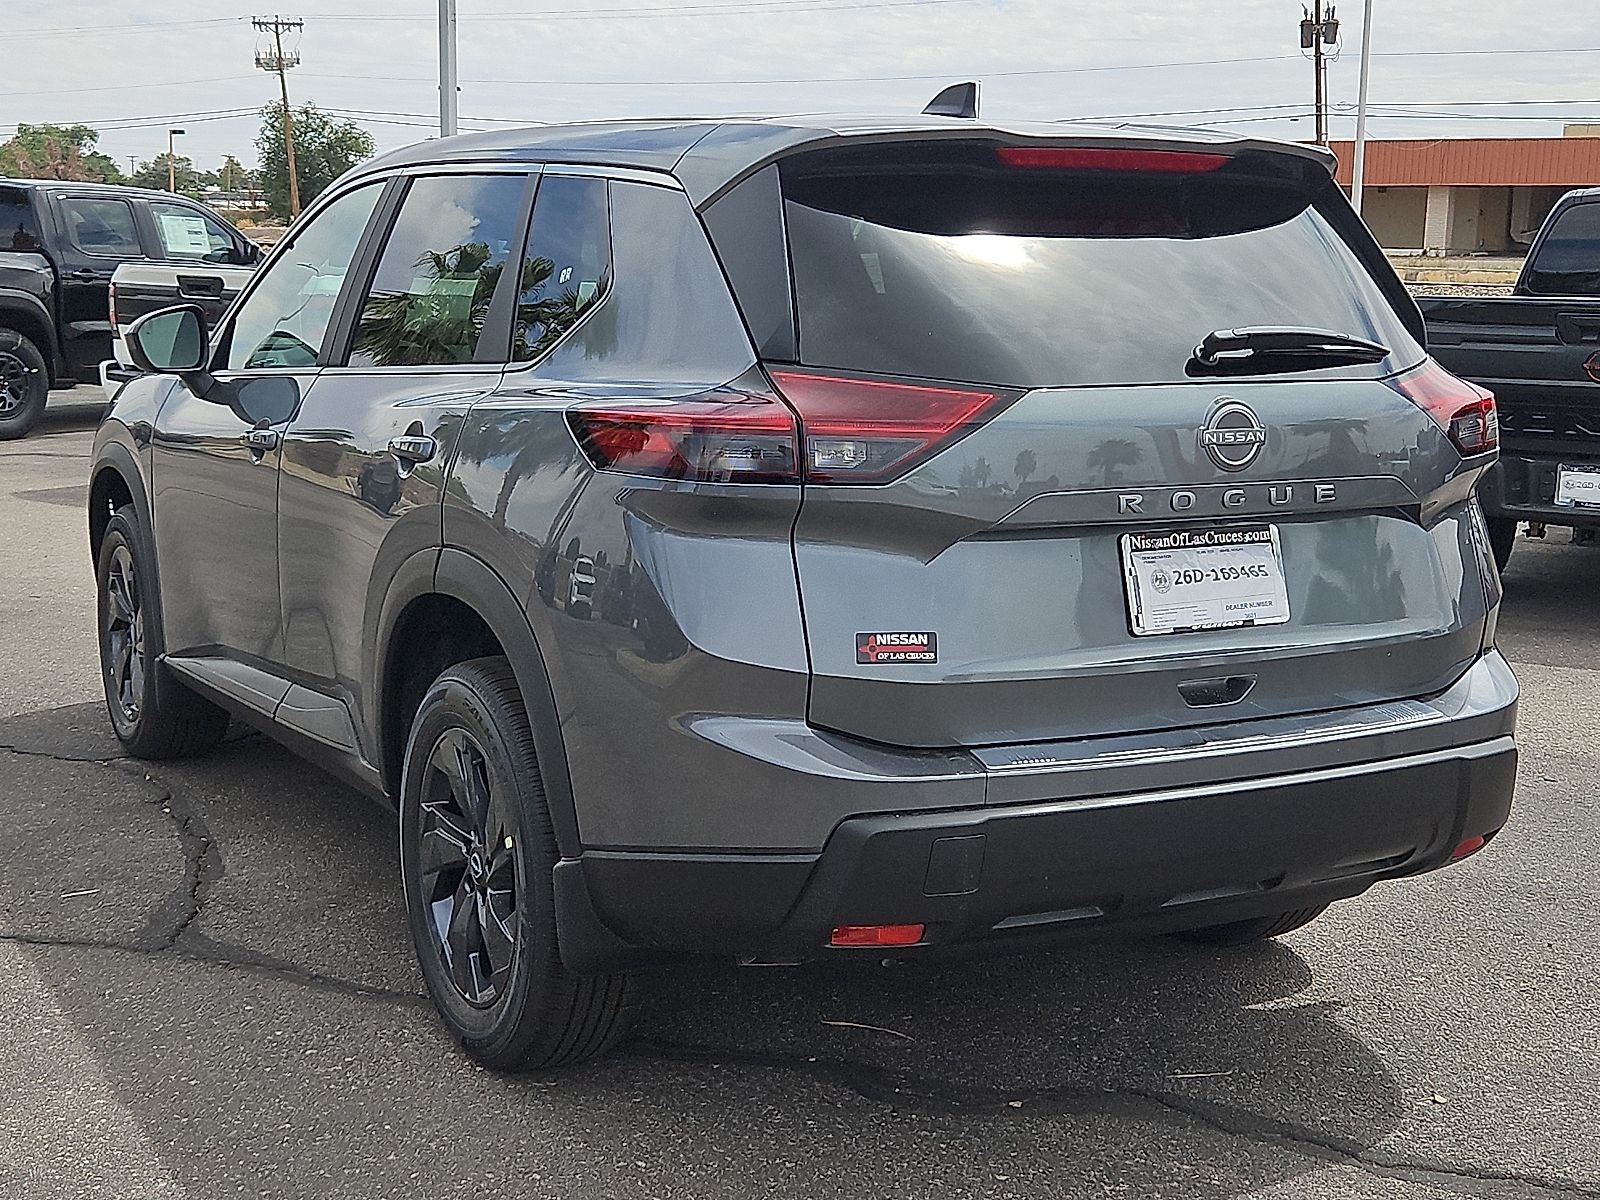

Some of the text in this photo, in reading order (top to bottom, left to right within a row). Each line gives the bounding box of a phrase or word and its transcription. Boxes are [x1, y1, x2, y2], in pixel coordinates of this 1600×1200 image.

[1205, 431, 1265, 444] NISSAN
[1117, 483, 1337, 514] ROGUE
[1130, 530, 1271, 549] NissanOfLasCruces.com
[1172, 564, 1269, 586] 26D-169465
[1225, 602, 1248, 611] DEALER
[876, 633, 928, 646] NISSAN
[878, 652, 889, 660] OF
[890, 652, 905, 660] LAS
